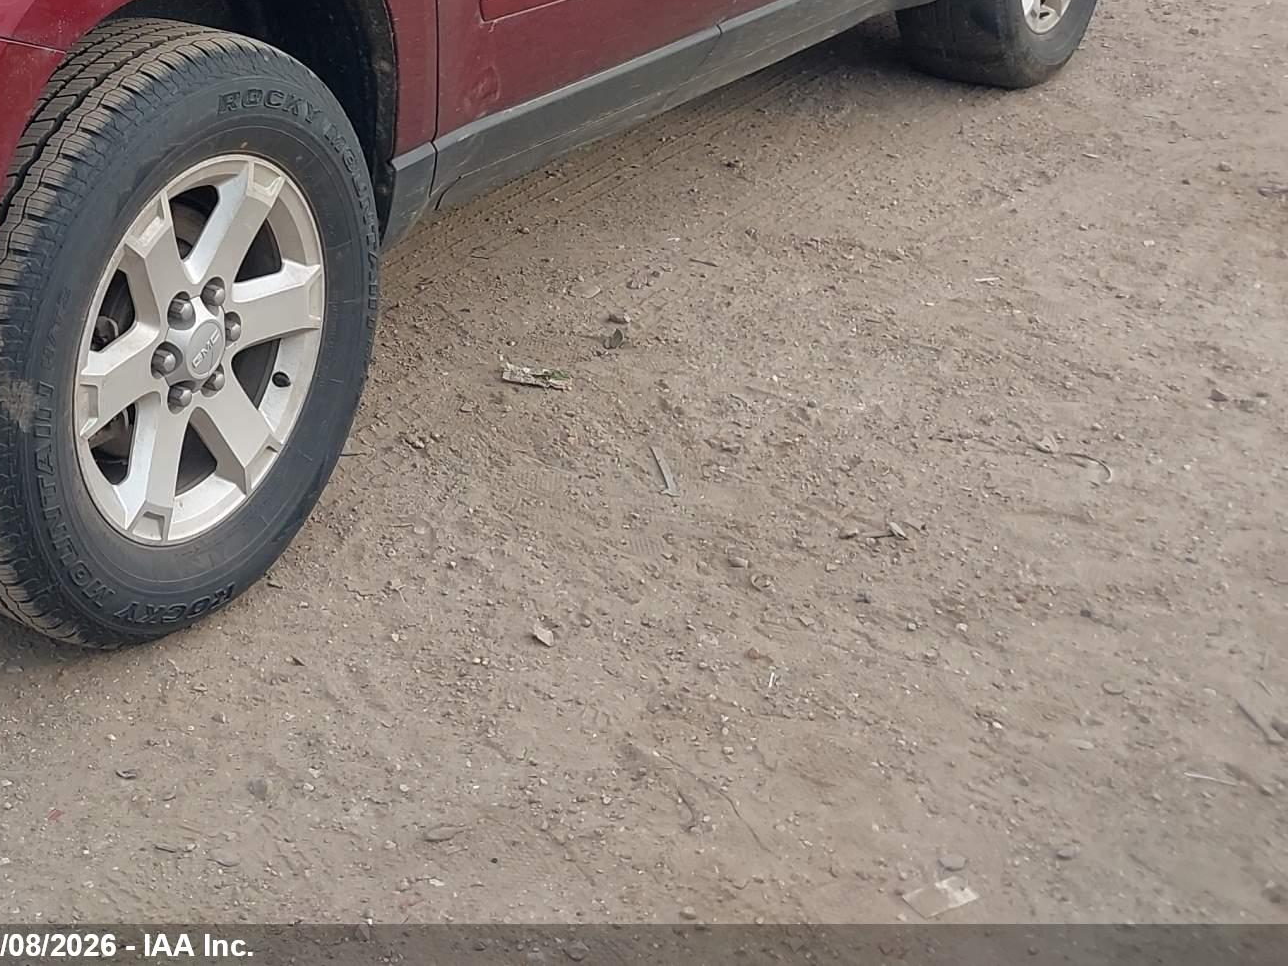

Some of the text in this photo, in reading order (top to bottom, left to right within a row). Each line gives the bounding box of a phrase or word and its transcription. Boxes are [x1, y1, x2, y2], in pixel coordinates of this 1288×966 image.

[217, 88, 323, 123] ROCKY
[192, 330, 220, 368] GMC
[114, 581, 236, 624] ROCKY
